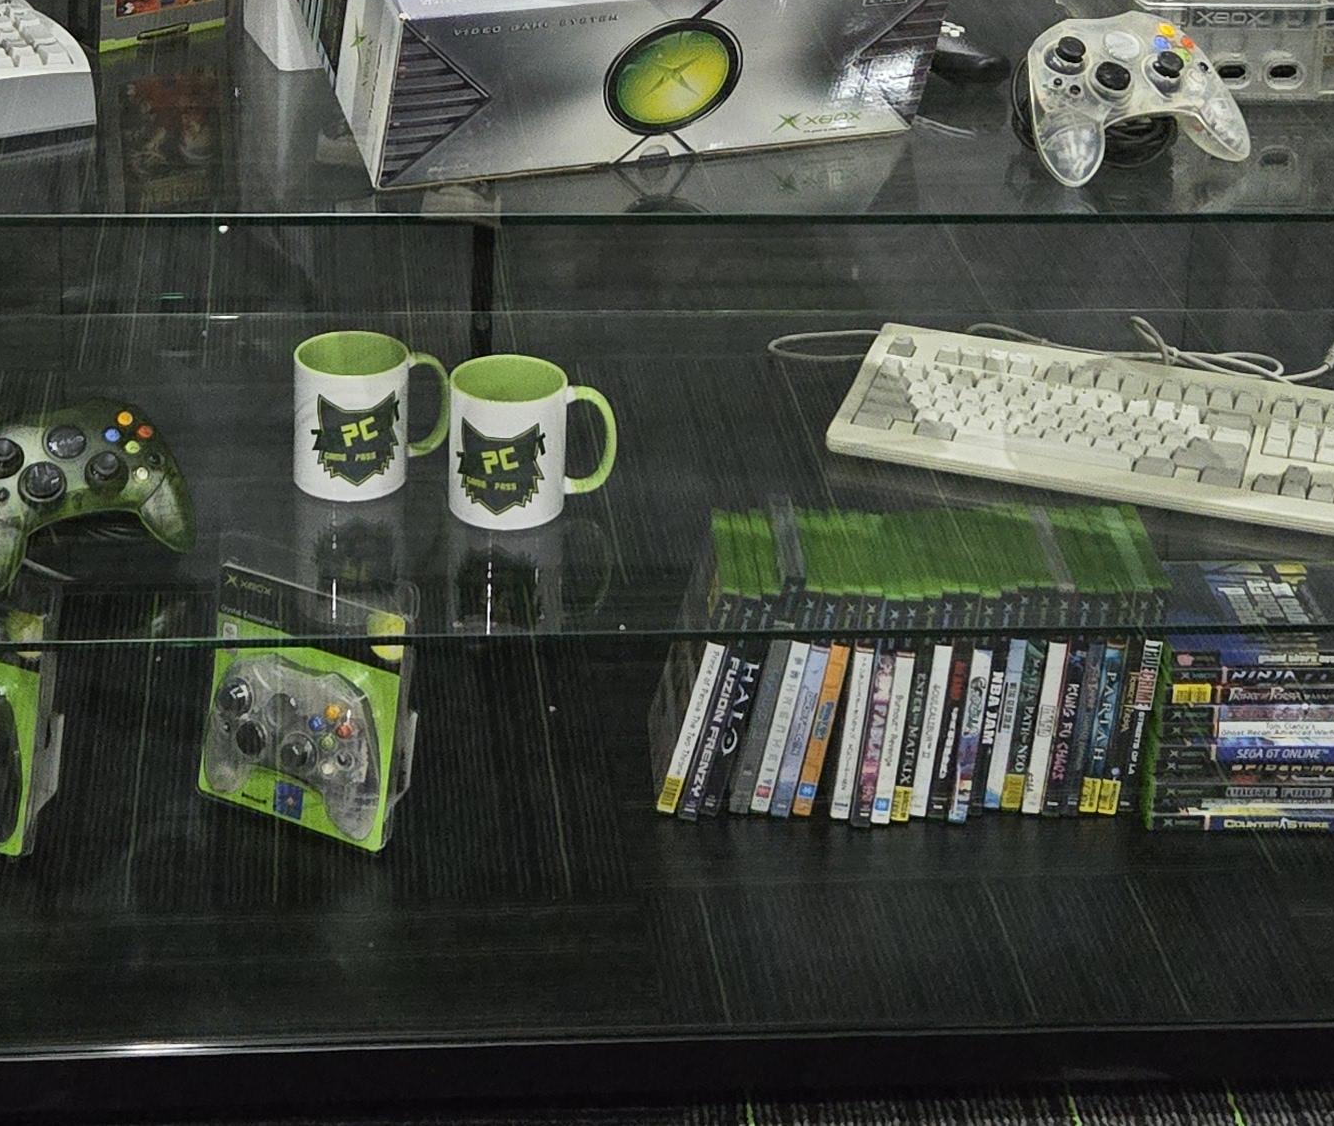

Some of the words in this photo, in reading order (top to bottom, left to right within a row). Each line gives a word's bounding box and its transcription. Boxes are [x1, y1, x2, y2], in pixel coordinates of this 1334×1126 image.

[453, 25, 502, 37] VIDEO
[1195, 9, 1267, 27] XBOX
[804, 111, 862, 125] XBOX
[340, 416, 379, 448] PC
[481, 446, 520, 475] PC
[240, 580, 273, 596] XBOX
[705, 650, 720, 677] Prince
[1142, 643, 1162, 674] TRUE
[987, 669, 1005, 707] NBA
[1135, 668, 1157, 710] CRIME
[1230, 669, 1297, 680] NINJA
[713, 656, 741, 724] FUZION
[1062, 682, 1080, 718] KUNG
[689, 715, 700, 730] The
[721, 661, 760, 758] HALO
[1020, 705, 1037, 737] PATH
[1093, 670, 1118, 761] PARIAH
[981, 709, 999, 745] JAM
[1058, 721, 1074, 738] FU
[1220, 728, 1245, 737] Ghost
[1273, 728, 1313, 737] Advanced
[1266, 722, 1282, 731] Tom
[691, 725, 721, 798] FRENZY
[899, 724, 921, 785] MATRIX
[1014, 743, 1029, 772] NEO
[1051, 742, 1069, 781] CHAOS
[1235, 748, 1264, 760] SEGA
[1266, 749, 1281, 760] GT
[1128, 763, 1137, 775] LA
